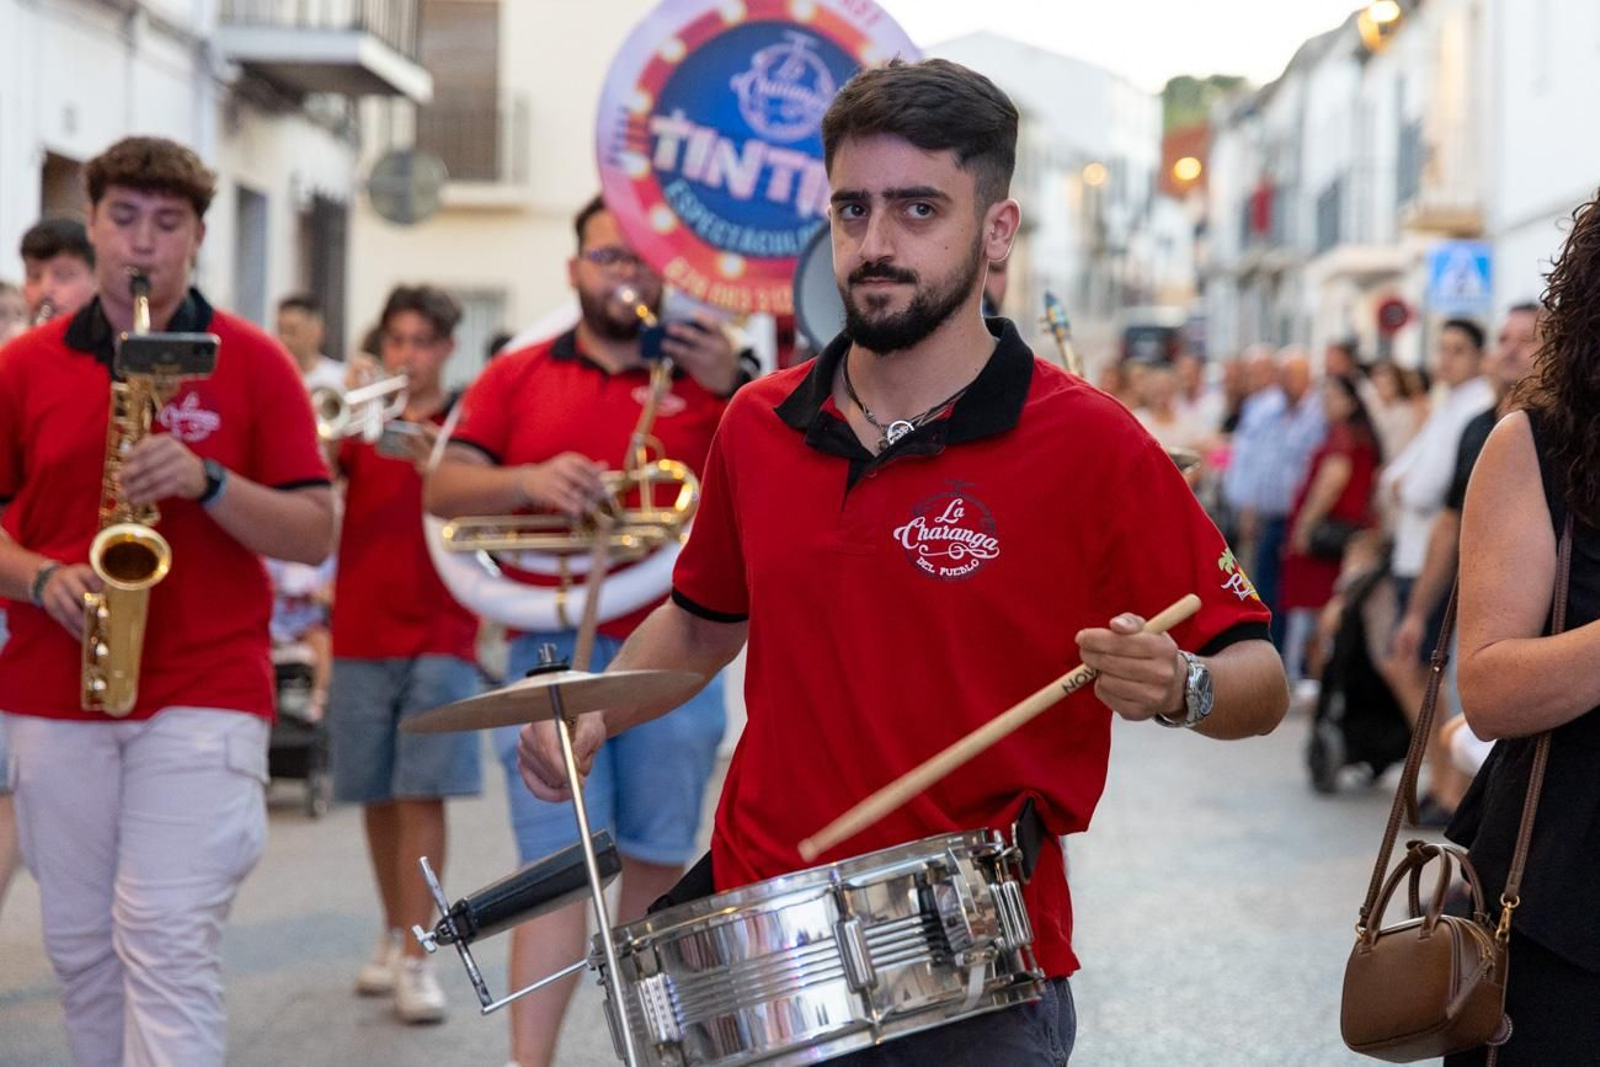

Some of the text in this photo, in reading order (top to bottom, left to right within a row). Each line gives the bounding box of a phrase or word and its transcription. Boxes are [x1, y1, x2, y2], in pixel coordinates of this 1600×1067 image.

[934, 497, 965, 525] La
[893, 516, 999, 556] Charanga
[916, 556, 980, 577] DEL PUEBLO
[1062, 667, 1100, 694] NOV
